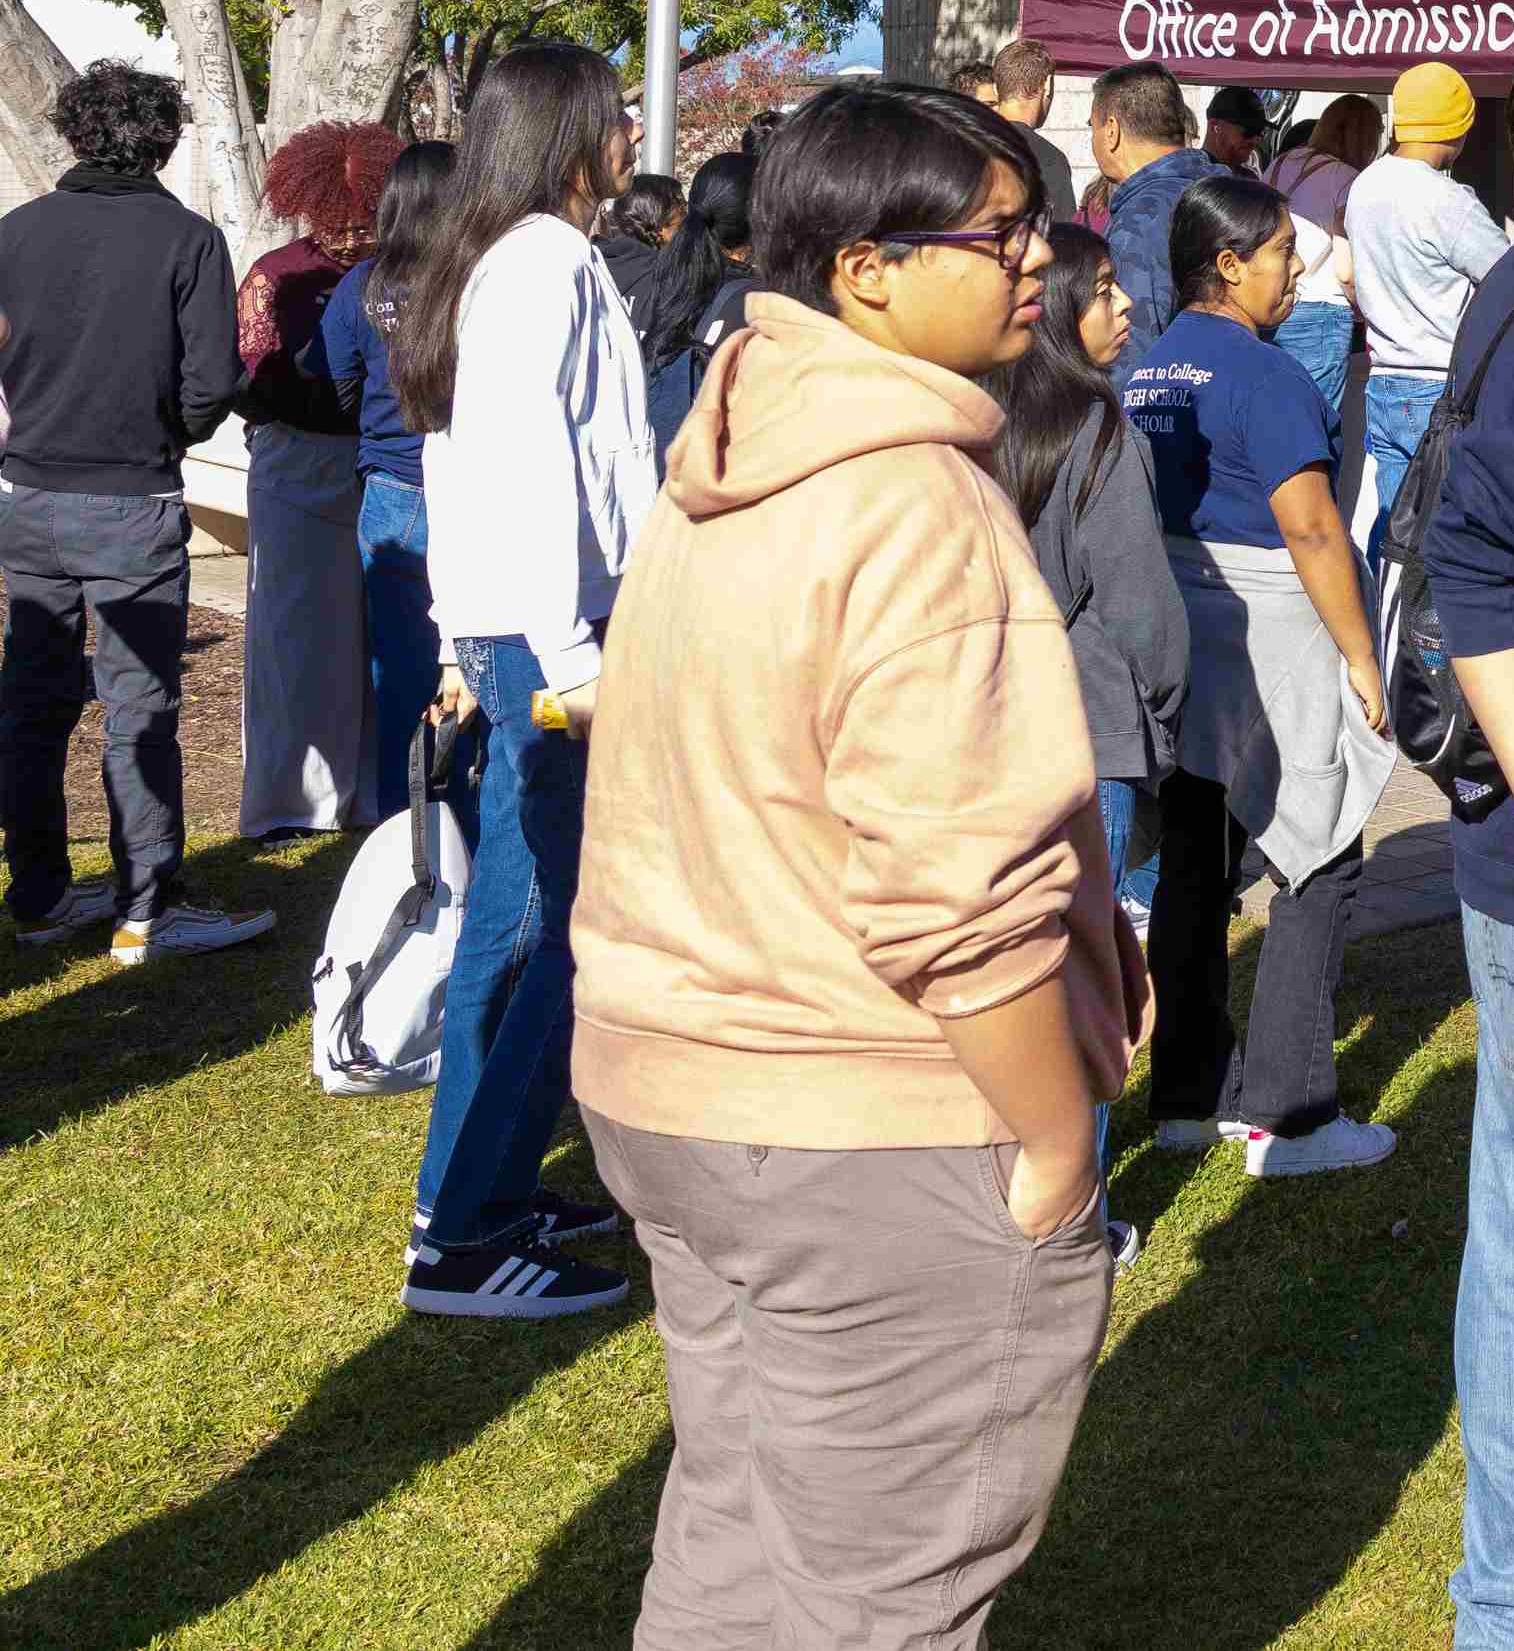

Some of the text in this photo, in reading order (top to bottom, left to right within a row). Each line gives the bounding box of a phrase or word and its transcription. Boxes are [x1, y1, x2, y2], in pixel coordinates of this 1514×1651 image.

[1155, 367, 1167, 382] to
[1167, 364, 1214, 386] College
[1148, 388, 1192, 408] SCHOOL
